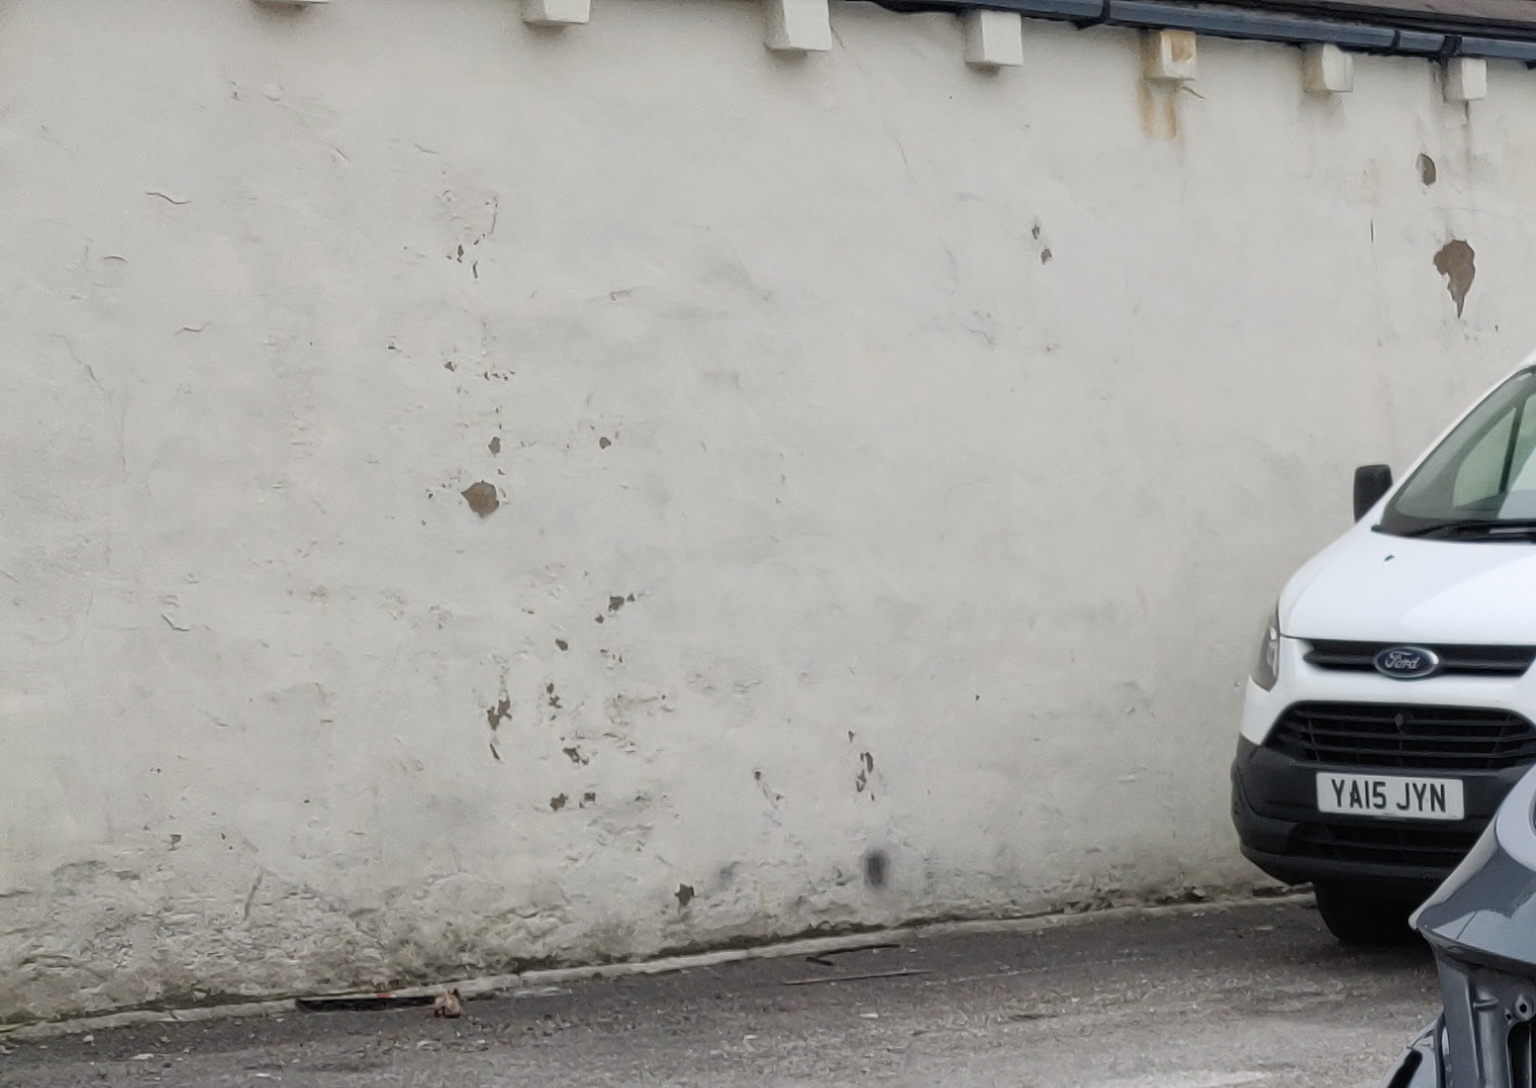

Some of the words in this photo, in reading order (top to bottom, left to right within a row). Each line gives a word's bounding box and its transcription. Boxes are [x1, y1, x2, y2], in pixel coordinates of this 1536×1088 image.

[1385, 651, 1421, 670] Ford
[1331, 779, 1387, 810] YA15
[1396, 782, 1447, 813] JYN
